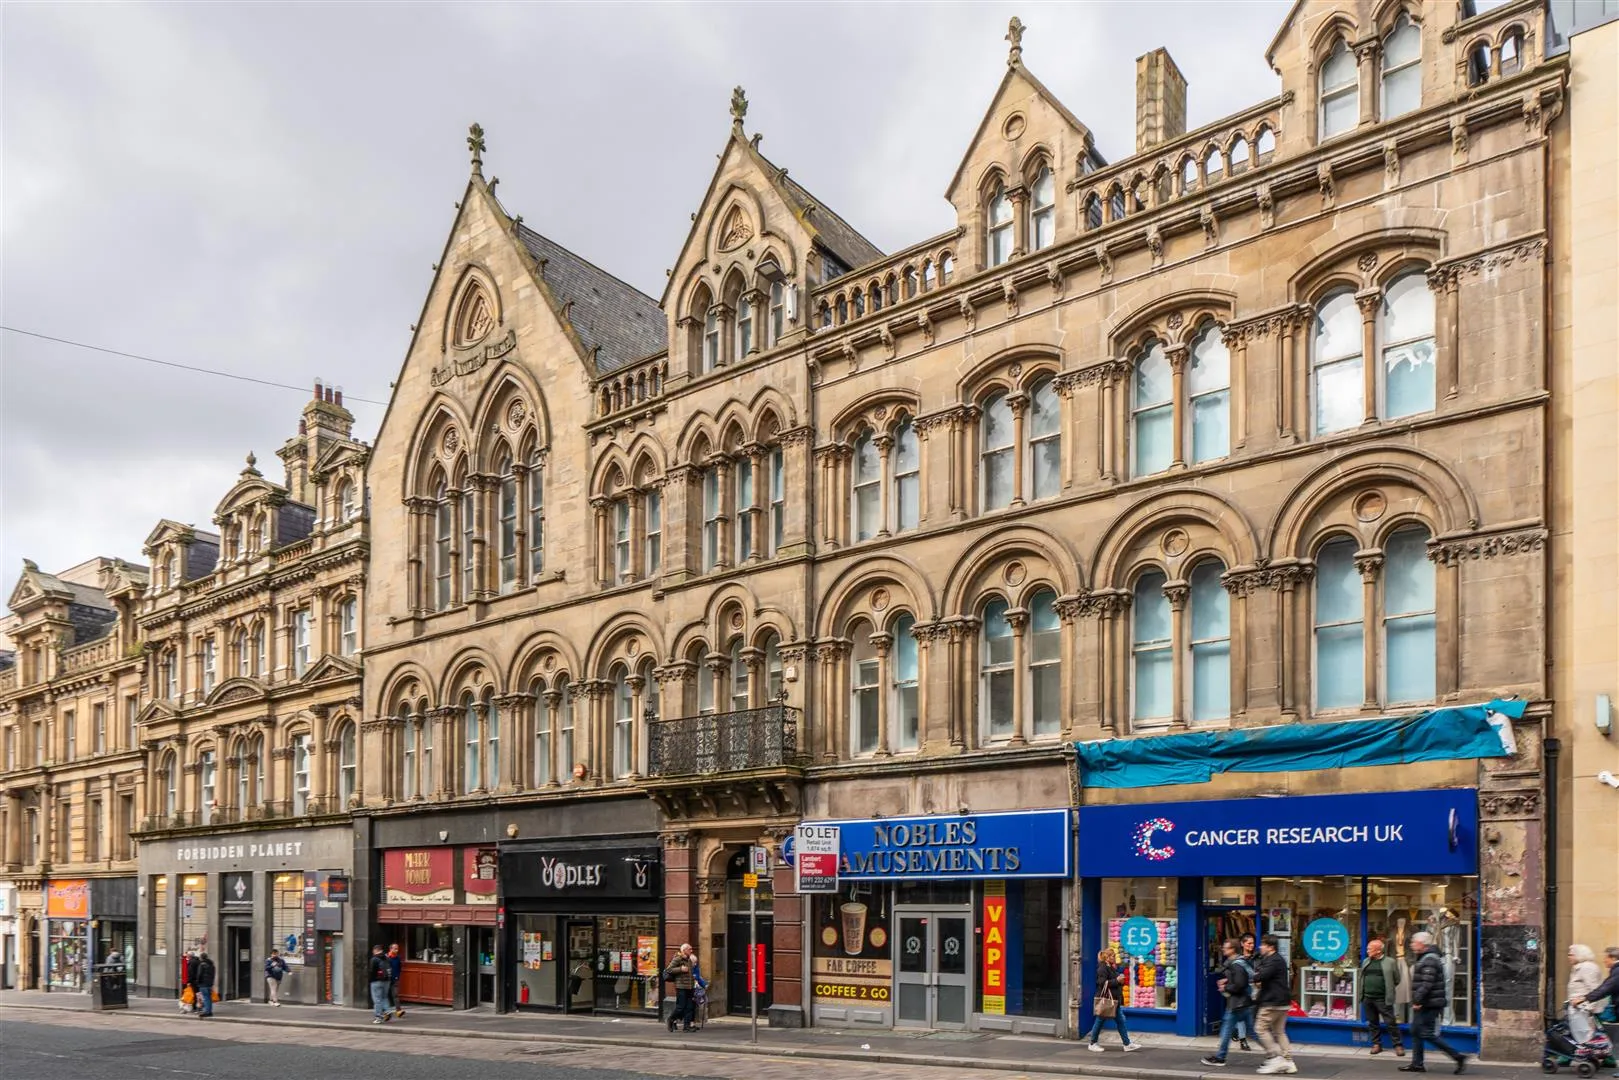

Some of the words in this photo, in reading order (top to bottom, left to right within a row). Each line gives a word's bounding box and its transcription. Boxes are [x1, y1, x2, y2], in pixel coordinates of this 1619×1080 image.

[798, 827, 814, 838] TO
[817, 827, 838, 839] LET
[873, 821, 977, 848] NOBLES
[1185, 829, 1259, 846] CANCER
[1267, 825, 1368, 844] RESEARCH
[1374, 824, 1404, 842] UK
[177, 845, 244, 861] FORBIDDEN
[250, 842, 302, 857] PLANET
[839, 847, 1021, 874] AMUSEMENTS
[1126, 927, 1152, 945] £5
[1311, 930, 1341, 950] £5
[986, 906, 1003, 986] VAPE
[826, 959, 843, 972] FAB
[846, 960, 877, 973] COFFEE
[816, 985, 857, 997] COFFEE
[860, 988, 867, 998] 2
[870, 988, 888, 999] GO
